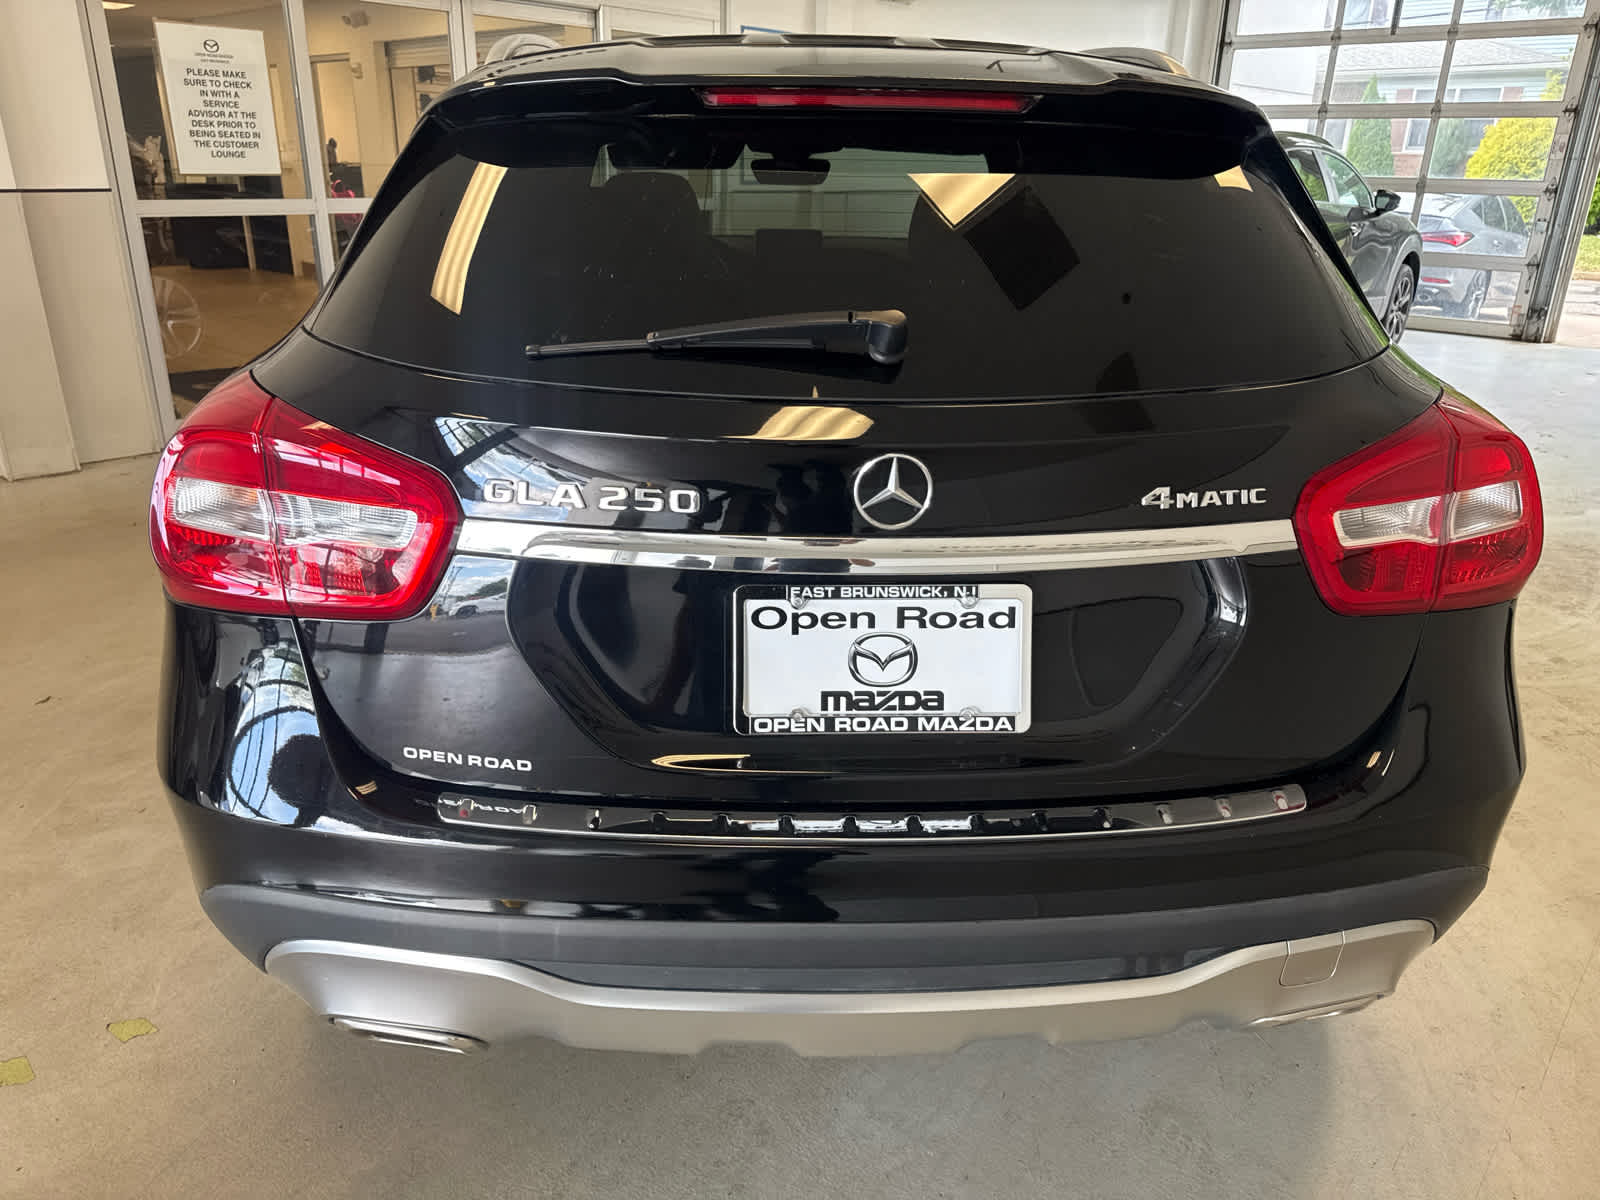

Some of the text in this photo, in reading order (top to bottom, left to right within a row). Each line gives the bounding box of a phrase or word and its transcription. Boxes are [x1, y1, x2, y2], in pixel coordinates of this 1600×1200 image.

[186, 68, 247, 79] PLEASE MAKE
[183, 78, 252, 89] SURE TO CHECK
[210, 90, 232, 98] WITH
[233, 91, 240, 99] A
[203, 100, 240, 109] SERVICE
[188, 109, 225, 118] ADVISOR
[228, 111, 238, 119] AT
[191, 120, 256, 129] DESK PRIOR TO
[189, 130, 216, 138] BEING
[218, 131, 251, 139] SEATED
[194, 140, 259, 149] THE CUSTOMER
[211, 151, 246, 159] LOUNGE
[484, 478, 701, 514] GLA 250
[1141, 486, 1267, 510] 4MATIC
[790, 586, 835, 599] EAST
[840, 586, 948, 598] BRUNSWICK,
[750, 606, 1016, 636] Open Road
[754, 716, 1013, 733] OPEN ROAD MAZDA
[402, 746, 533, 772] OPEN ROAD
